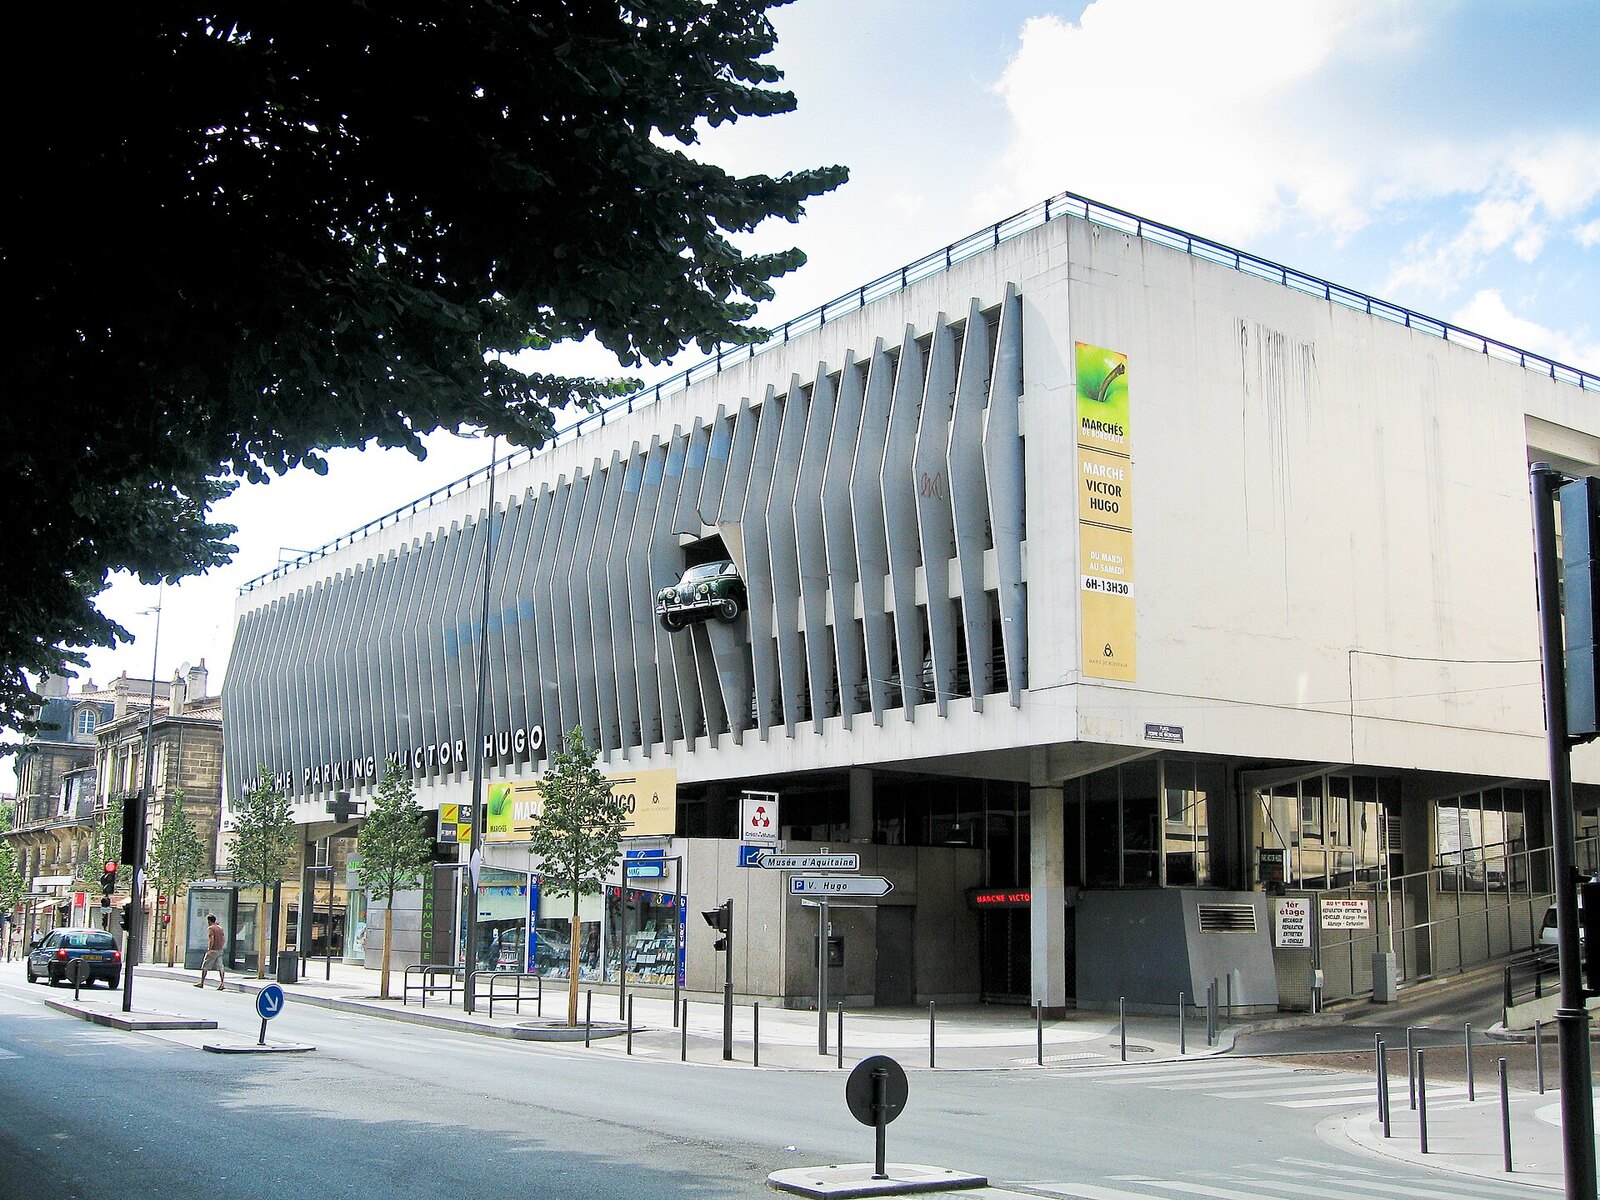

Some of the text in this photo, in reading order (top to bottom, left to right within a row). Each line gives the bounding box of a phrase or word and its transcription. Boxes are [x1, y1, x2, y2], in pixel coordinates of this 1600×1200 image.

[1082, 417, 1124, 437] MARCHÉS
[1083, 461, 1125, 481] MARCHÉ
[1086, 478, 1122, 498] VICTOR
[1090, 497, 1119, 513] HUGO
[1090, 550, 1123, 564] DU MARDI
[1089, 562, 1126, 576] AU SAMEDI
[1085, 578, 1129, 595] 6H-13H30
[303, 756, 375, 786] PARKING
[387, 738, 464, 773] VICTOR
[483, 724, 543, 758] HUGO
[767, 858, 854, 868] Musée d'Aquitaine
[808, 881, 817, 889] V.
[823, 881, 848, 891] Hugo
[1008, 893, 1031, 902] VICTO
[422, 873, 434, 960] PHARMACIE
